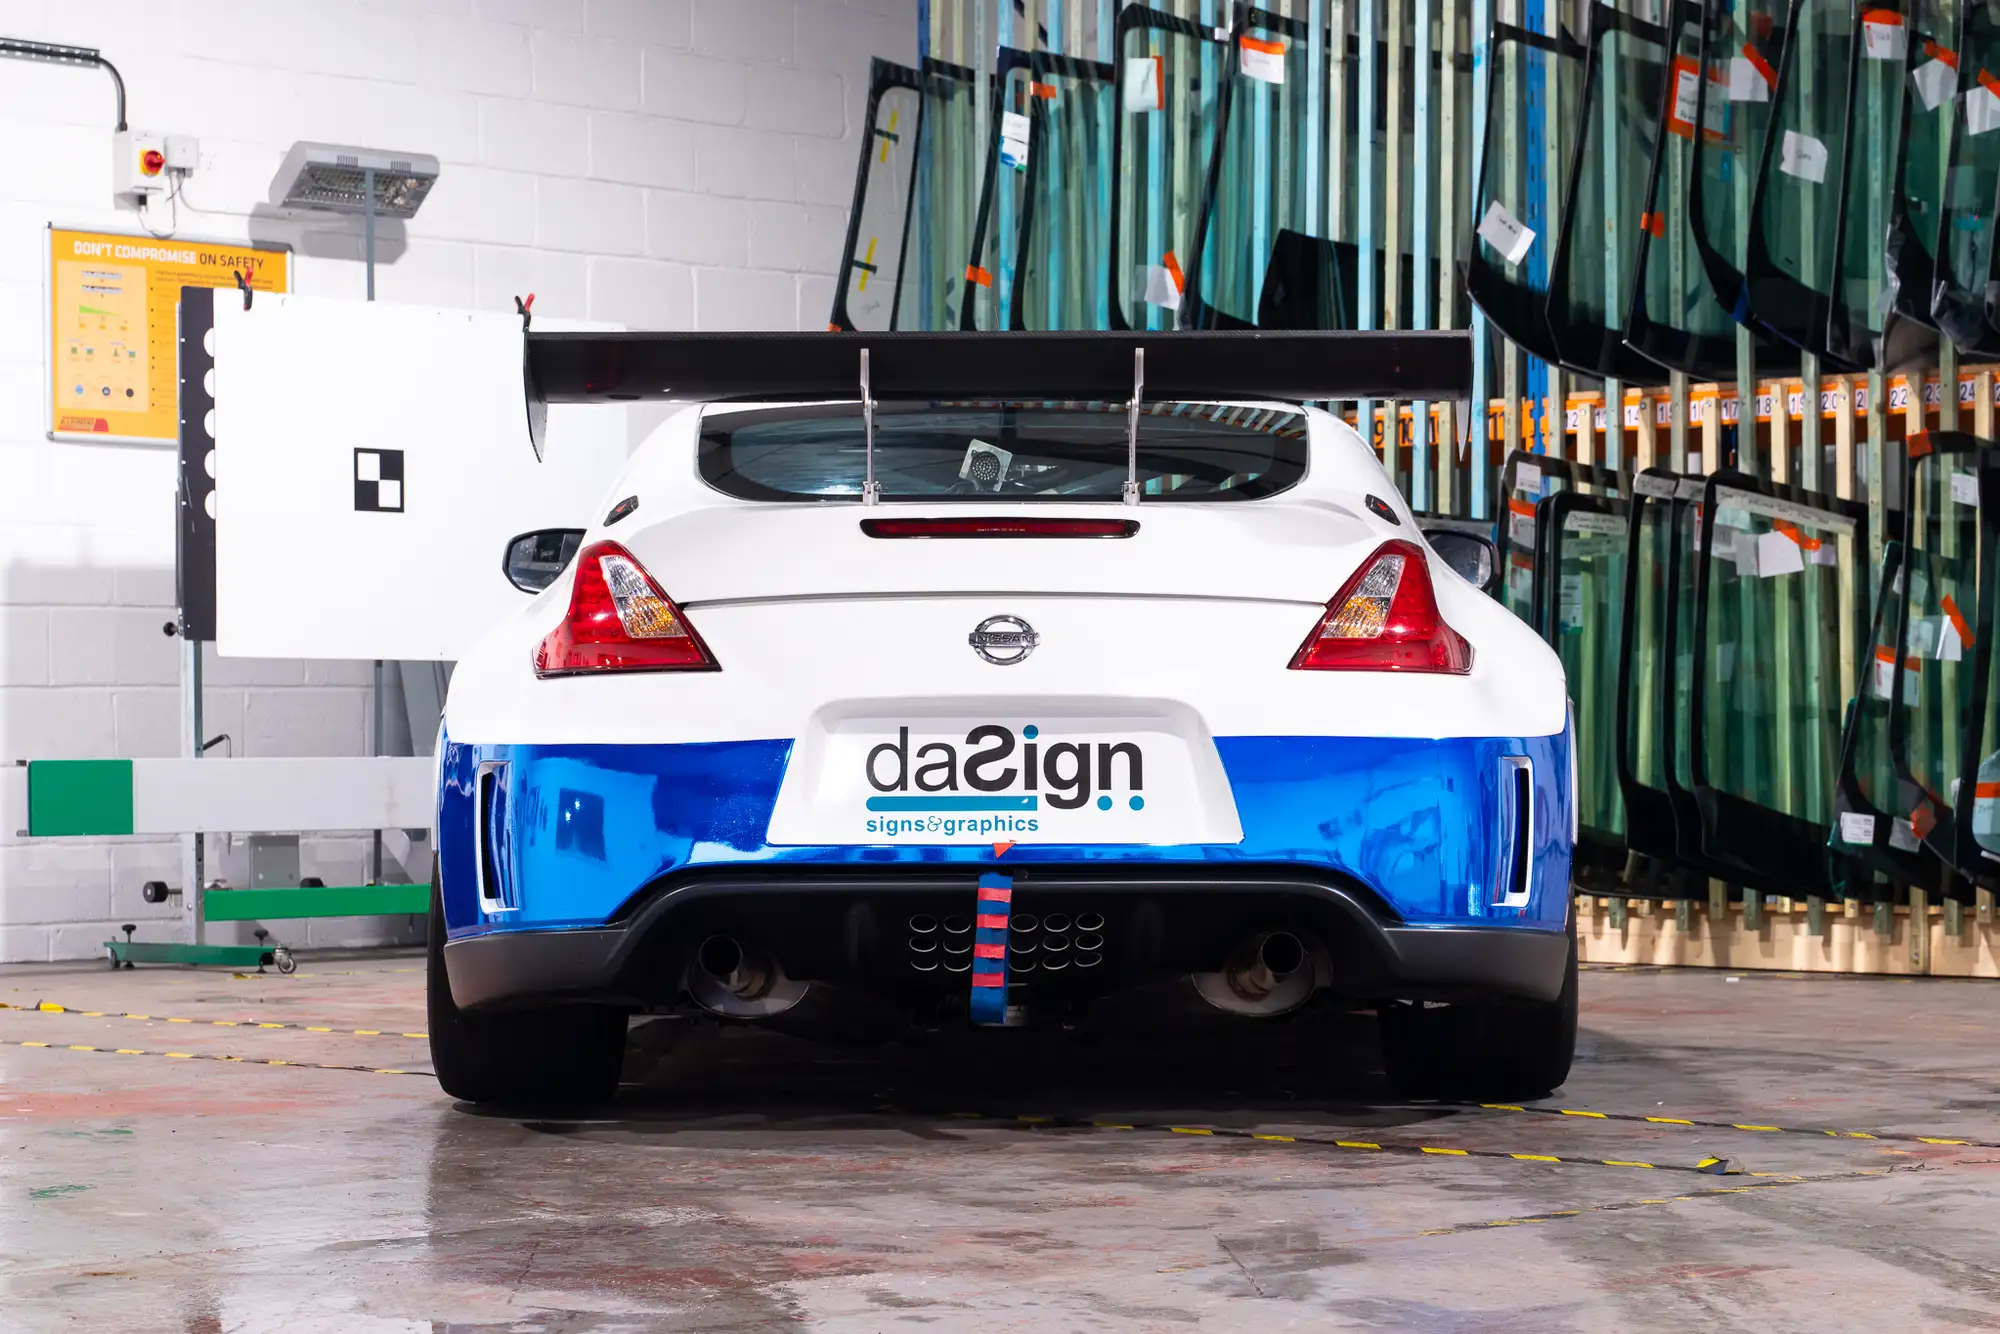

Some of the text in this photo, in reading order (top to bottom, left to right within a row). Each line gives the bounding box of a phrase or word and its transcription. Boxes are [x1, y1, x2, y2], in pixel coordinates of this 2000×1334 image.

[73, 240, 264, 269] DON'T COMPROMISE ON SAFETY
[1756, 397, 1771, 415] 18
[975, 633, 1032, 644] NISSAN
